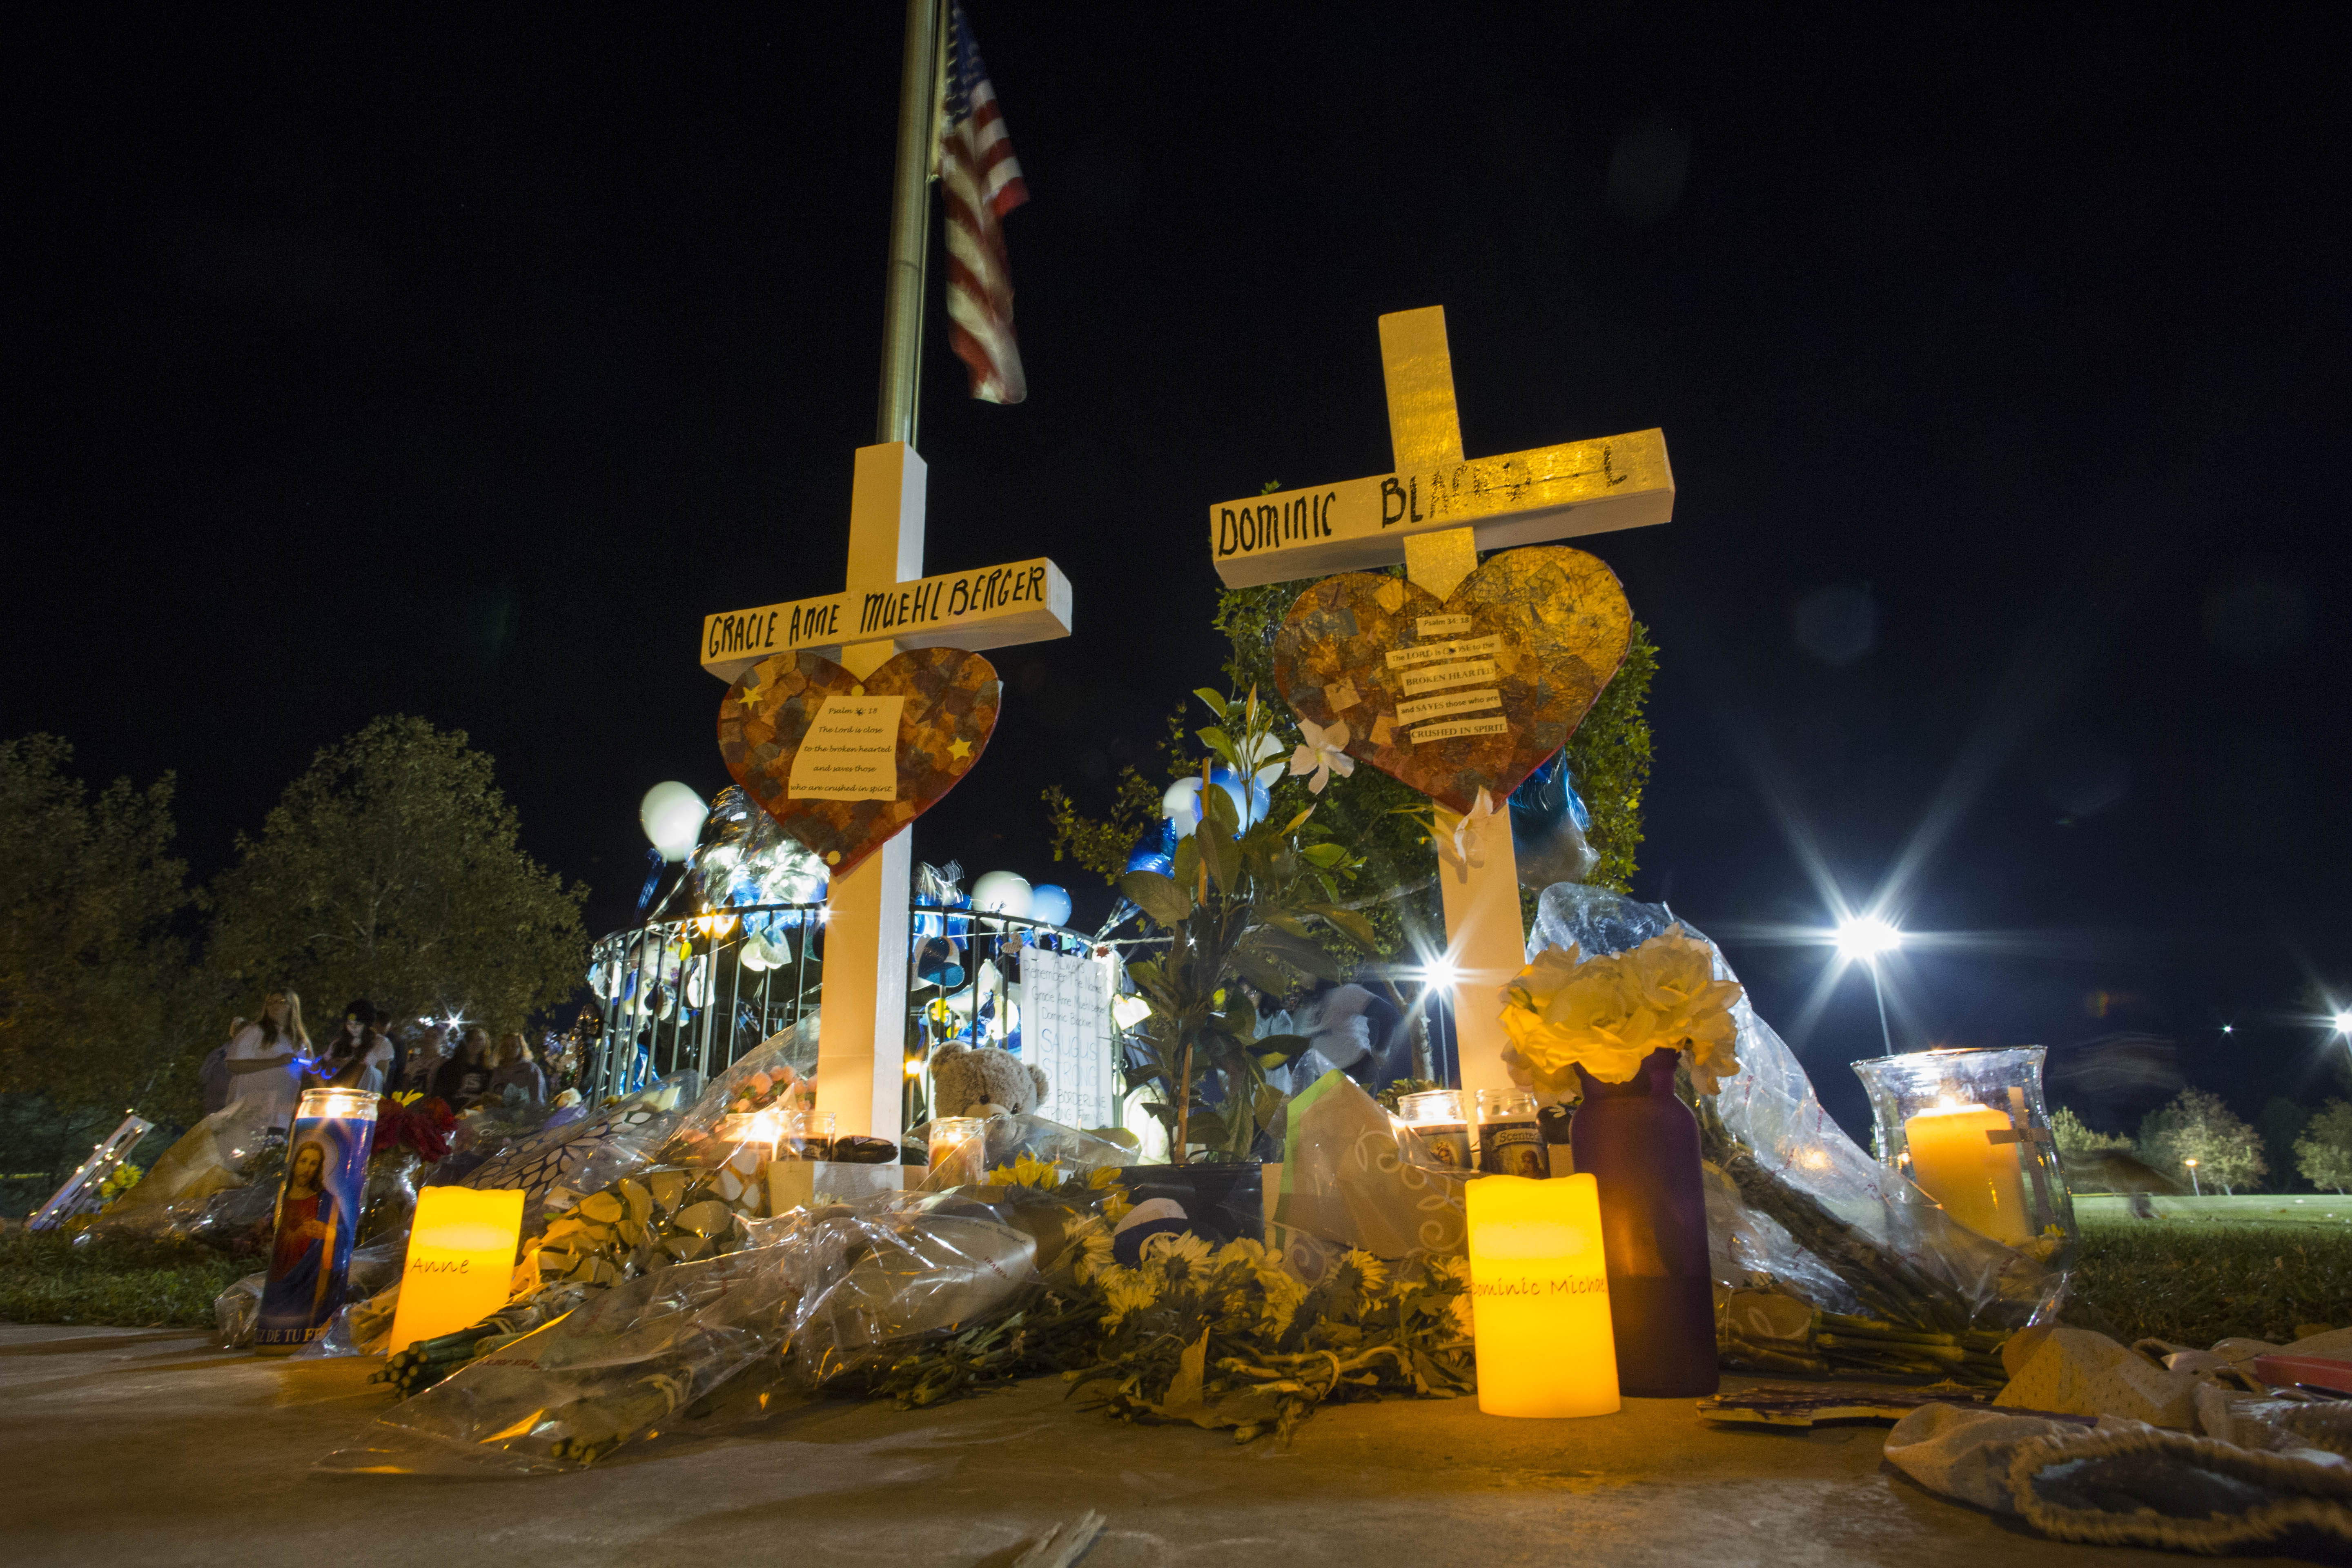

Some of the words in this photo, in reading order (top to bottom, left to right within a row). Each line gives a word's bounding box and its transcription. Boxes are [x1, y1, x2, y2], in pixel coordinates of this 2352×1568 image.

[1218, 492, 1336, 556] DOMINIC
[709, 611, 778, 658] GRACIE
[1407, 649, 1433, 660] LORD
[1443, 644, 1471, 655] COSE
[1406, 674, 1446, 686] BROKEN
[1449, 668, 1494, 680] HEARTED
[1416, 701, 1444, 712] SAVES
[1446, 700, 1467, 708] those
[1411, 728, 1457, 739] CRUSHED
[1023, 960, 1067, 983] Remember
[1068, 971, 1083, 989] The
[1031, 986, 1055, 1002] Gracie
[1042, 1007, 1068, 1023] Dominic
[1040, 1028, 1098, 1061] SAUGUS
[1042, 1058, 1098, 1087] STRONG
[1057, 1088, 1107, 1108] BORDERLINE
[1038, 1105, 1072, 1121] STRONG
[410, 1257, 469, 1274] Anne
[266, 1329, 281, 1343] DE
[284, 1329, 303, 1343] TU
